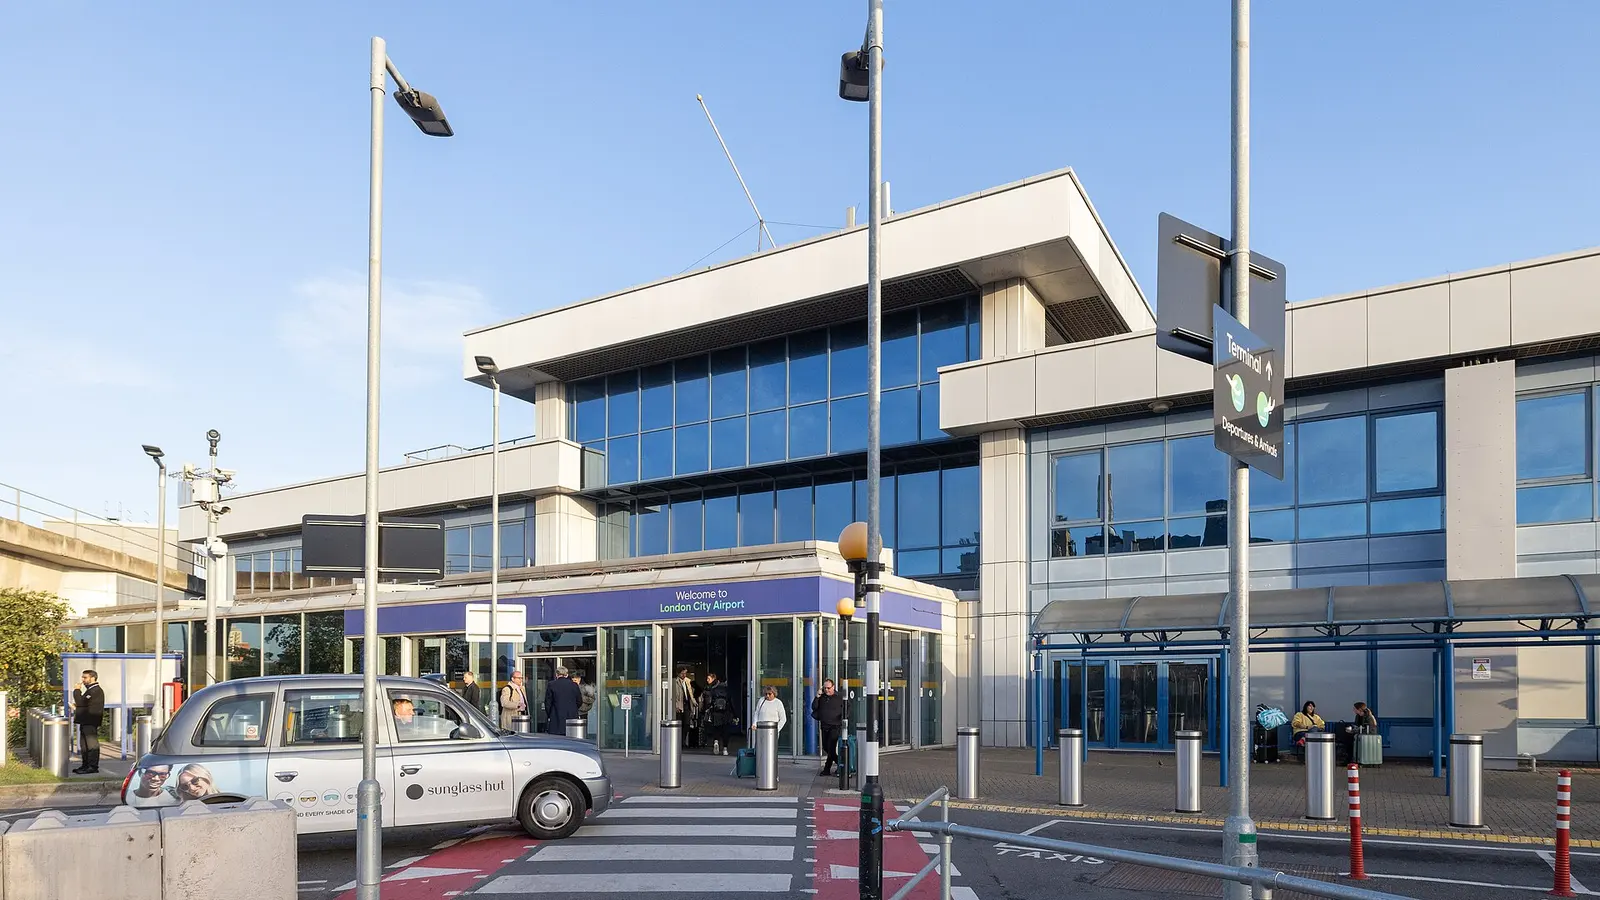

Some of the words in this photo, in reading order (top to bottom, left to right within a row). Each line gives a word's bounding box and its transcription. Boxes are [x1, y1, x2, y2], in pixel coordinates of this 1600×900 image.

[1226, 332, 1262, 375] Terminal
[1222, 416, 1254, 447] Departures
[1254, 434, 1260, 448] &
[1259, 437, 1278, 458] Arrivals
[675, 590, 717, 601] Welcome
[718, 589, 728, 598] to
[660, 603, 692, 613] London
[693, 601, 712, 612] City
[713, 599, 745, 612] Airport
[428, 782, 482, 797] sunglass
[485, 780, 505, 792] hut
[995, 847, 1104, 865] TAXIS
